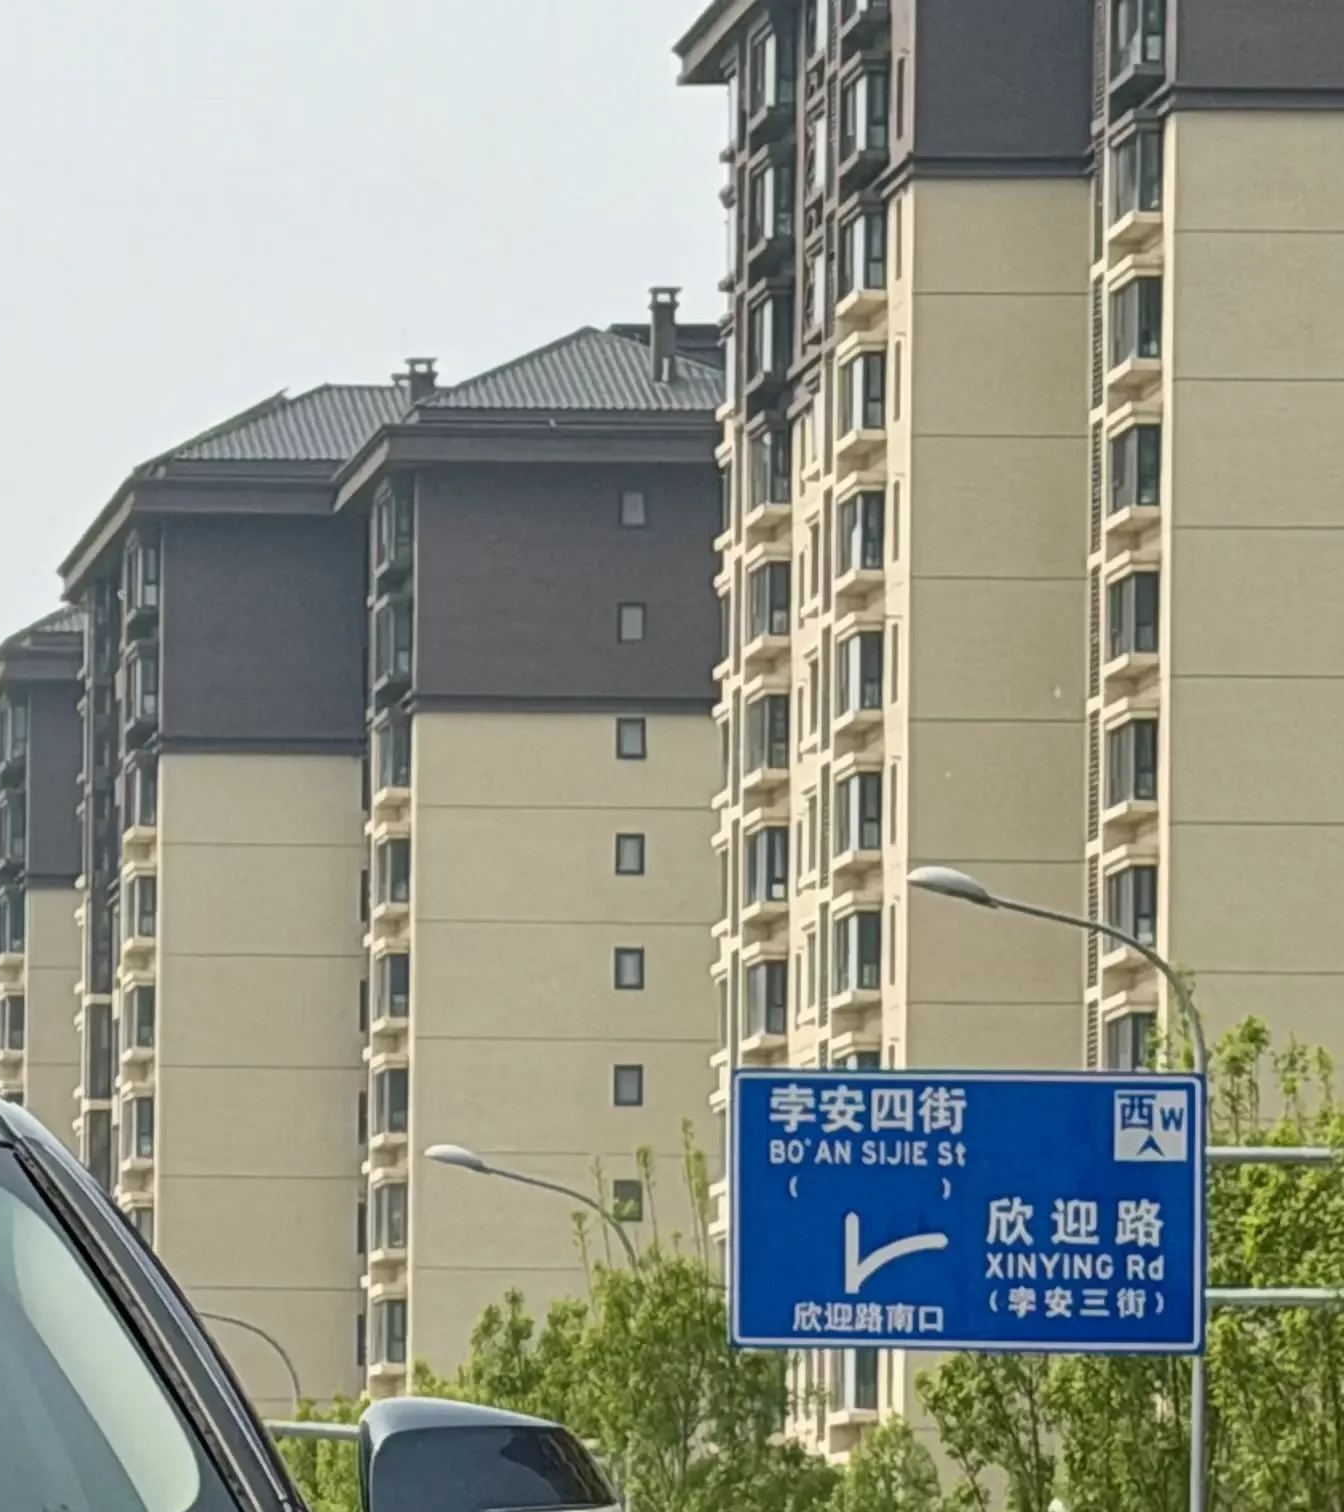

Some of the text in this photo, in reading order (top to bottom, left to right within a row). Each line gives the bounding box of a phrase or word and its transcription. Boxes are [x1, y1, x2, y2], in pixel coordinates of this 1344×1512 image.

[769, 1083, 968, 1135] 孛安四街
[1117, 1093, 1185, 1132] 西 W
[861, 1139, 928, 1166] SIJIE
[937, 1141, 967, 1167] St
[985, 1196, 1164, 1248] 欣迎路
[984, 1251, 1164, 1281] XINYING Rd
[792, 1301, 944, 1334] 欣迎路南口
